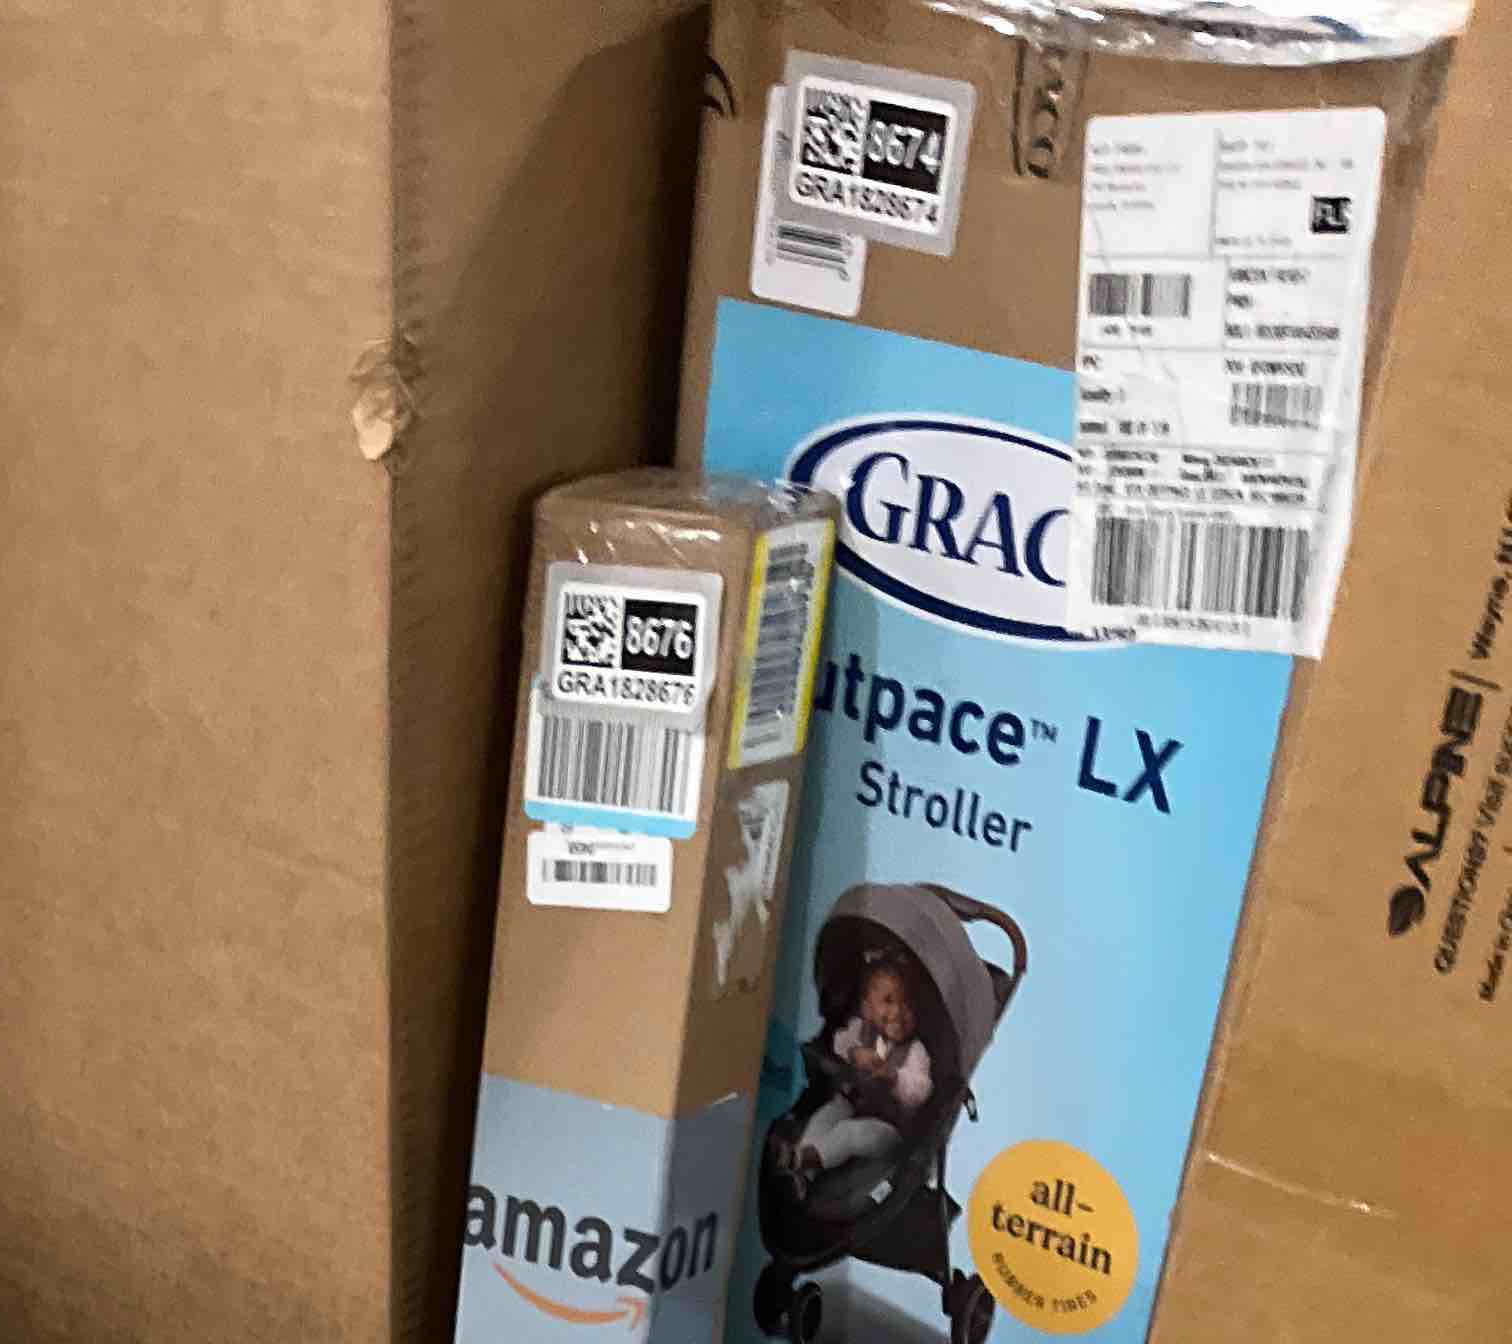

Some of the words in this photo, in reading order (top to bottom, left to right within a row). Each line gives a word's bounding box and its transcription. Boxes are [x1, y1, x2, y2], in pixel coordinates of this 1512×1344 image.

[846, 450, 1071, 588] GRAC
[623, 613, 695, 659] 8676
[557, 669, 696, 703] GRA1828676
[855, 760, 1033, 854] Stroller
[1077, 715, 1185, 816] LX
[1404, 684, 1484, 893] ALPINE
[464, 1183, 719, 1296] amazon
[991, 1200, 1113, 1276] terrain
[1030, 1179, 1094, 1219] all-
